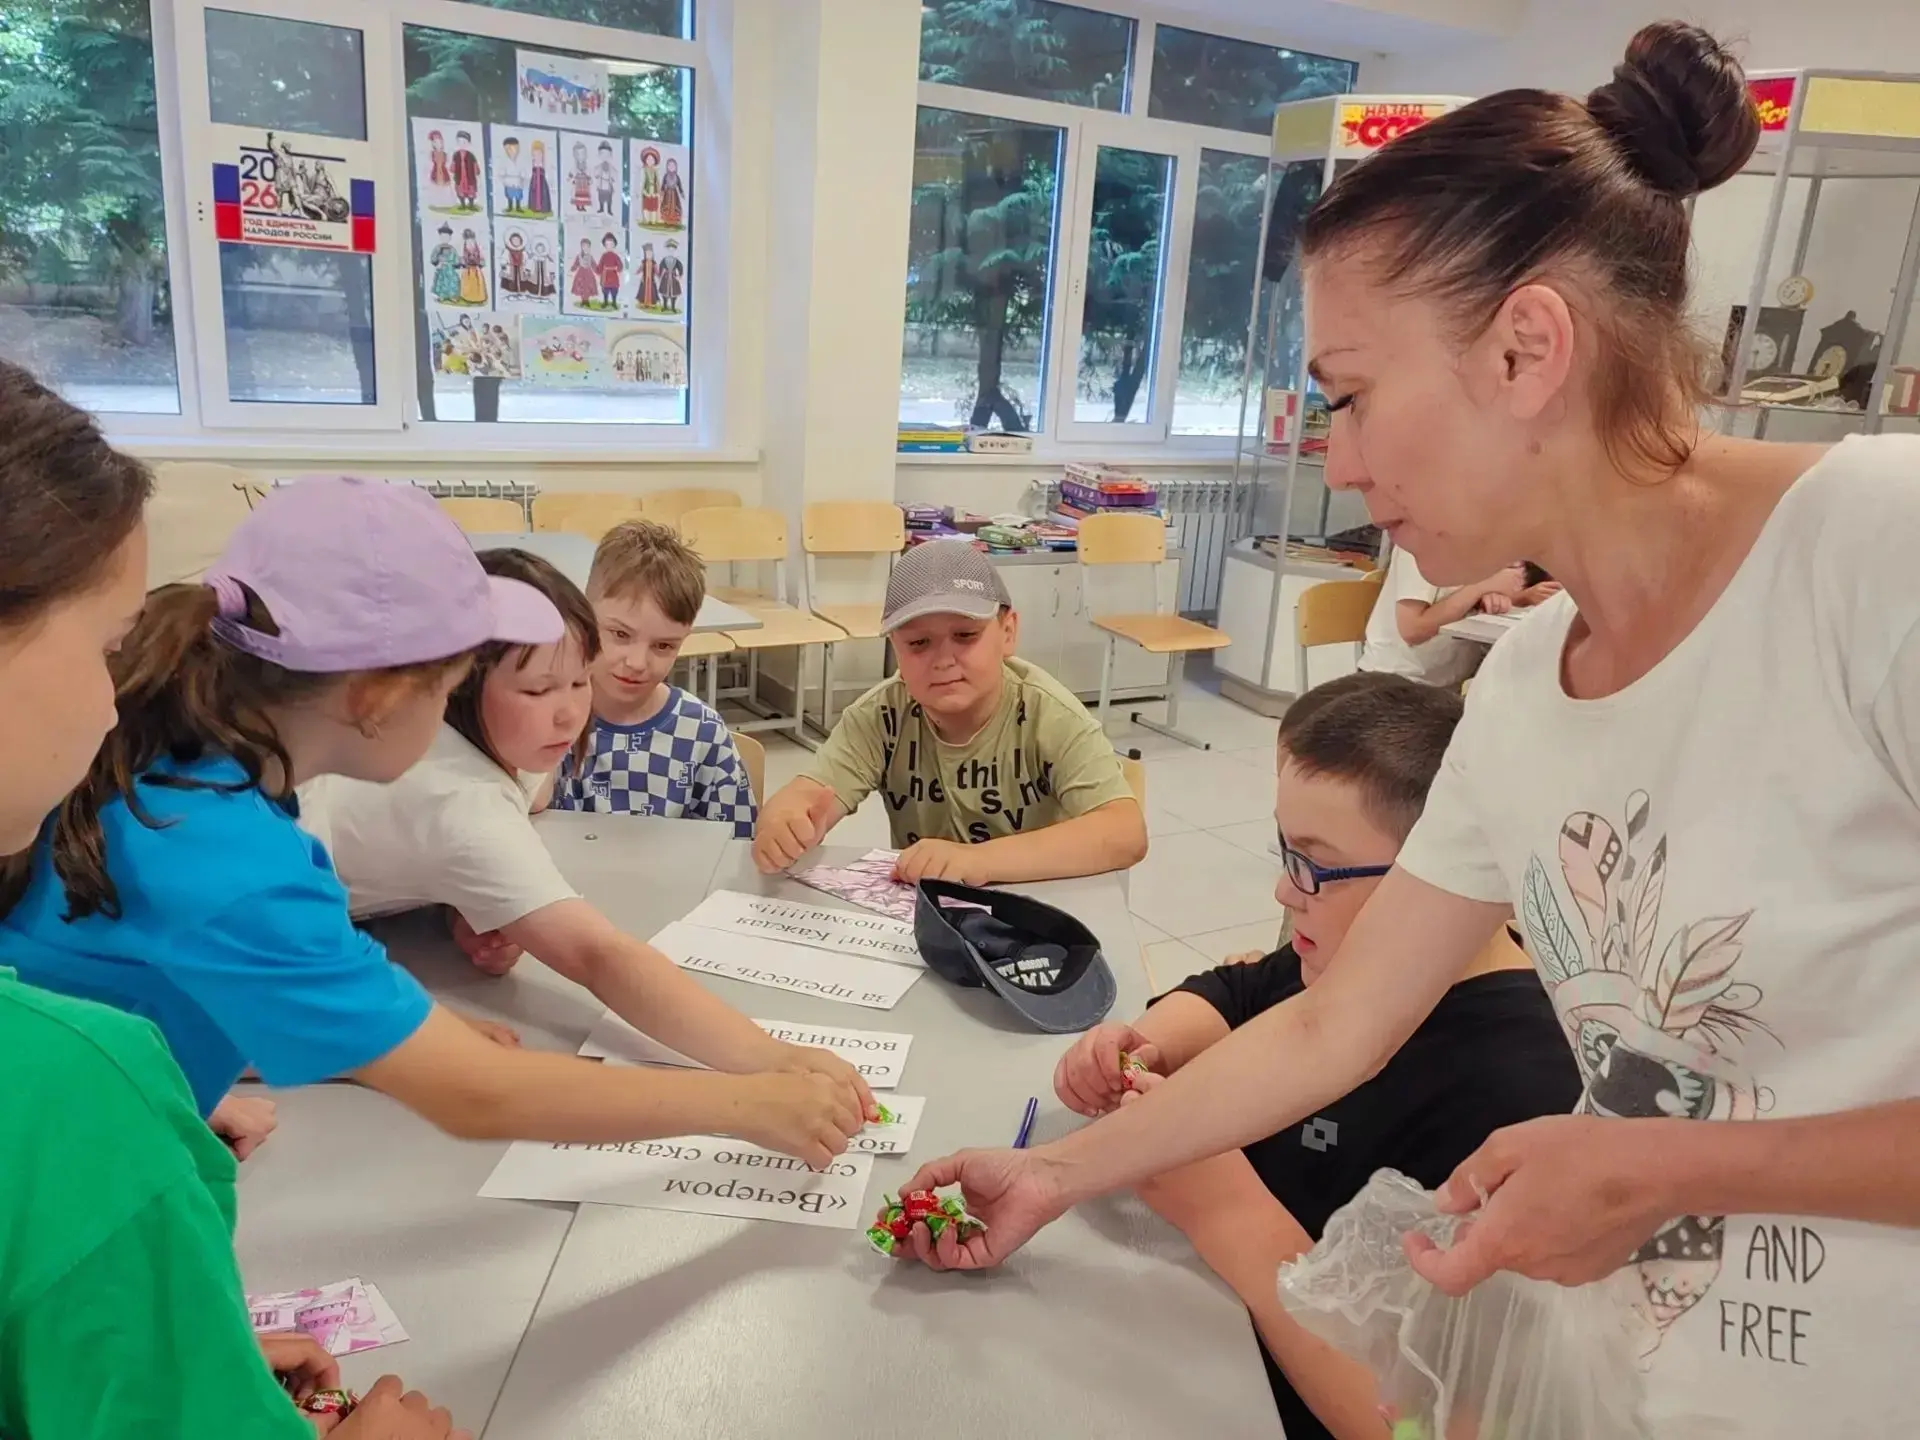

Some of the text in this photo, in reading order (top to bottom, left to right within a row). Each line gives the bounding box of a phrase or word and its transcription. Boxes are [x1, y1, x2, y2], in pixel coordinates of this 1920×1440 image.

[240, 154, 277, 182] 20
[241, 181, 278, 209] 26
[244, 217, 317, 231] ГОД ЕДИНСТВА
[244, 227, 333, 241] НАРОДОВ РОССИИ
[953, 579, 984, 591] SPORT
[736, 917, 919, 956] казки! Каждая
[684, 955, 891, 1003] за прелесть эти
[857, 1064, 891, 1076] св
[585, 1141, 702, 1161] сказки
[663, 1179, 848, 1214] «Вечером
[1746, 1224, 1826, 1284] AND
[1720, 1299, 1812, 1367] FREE
